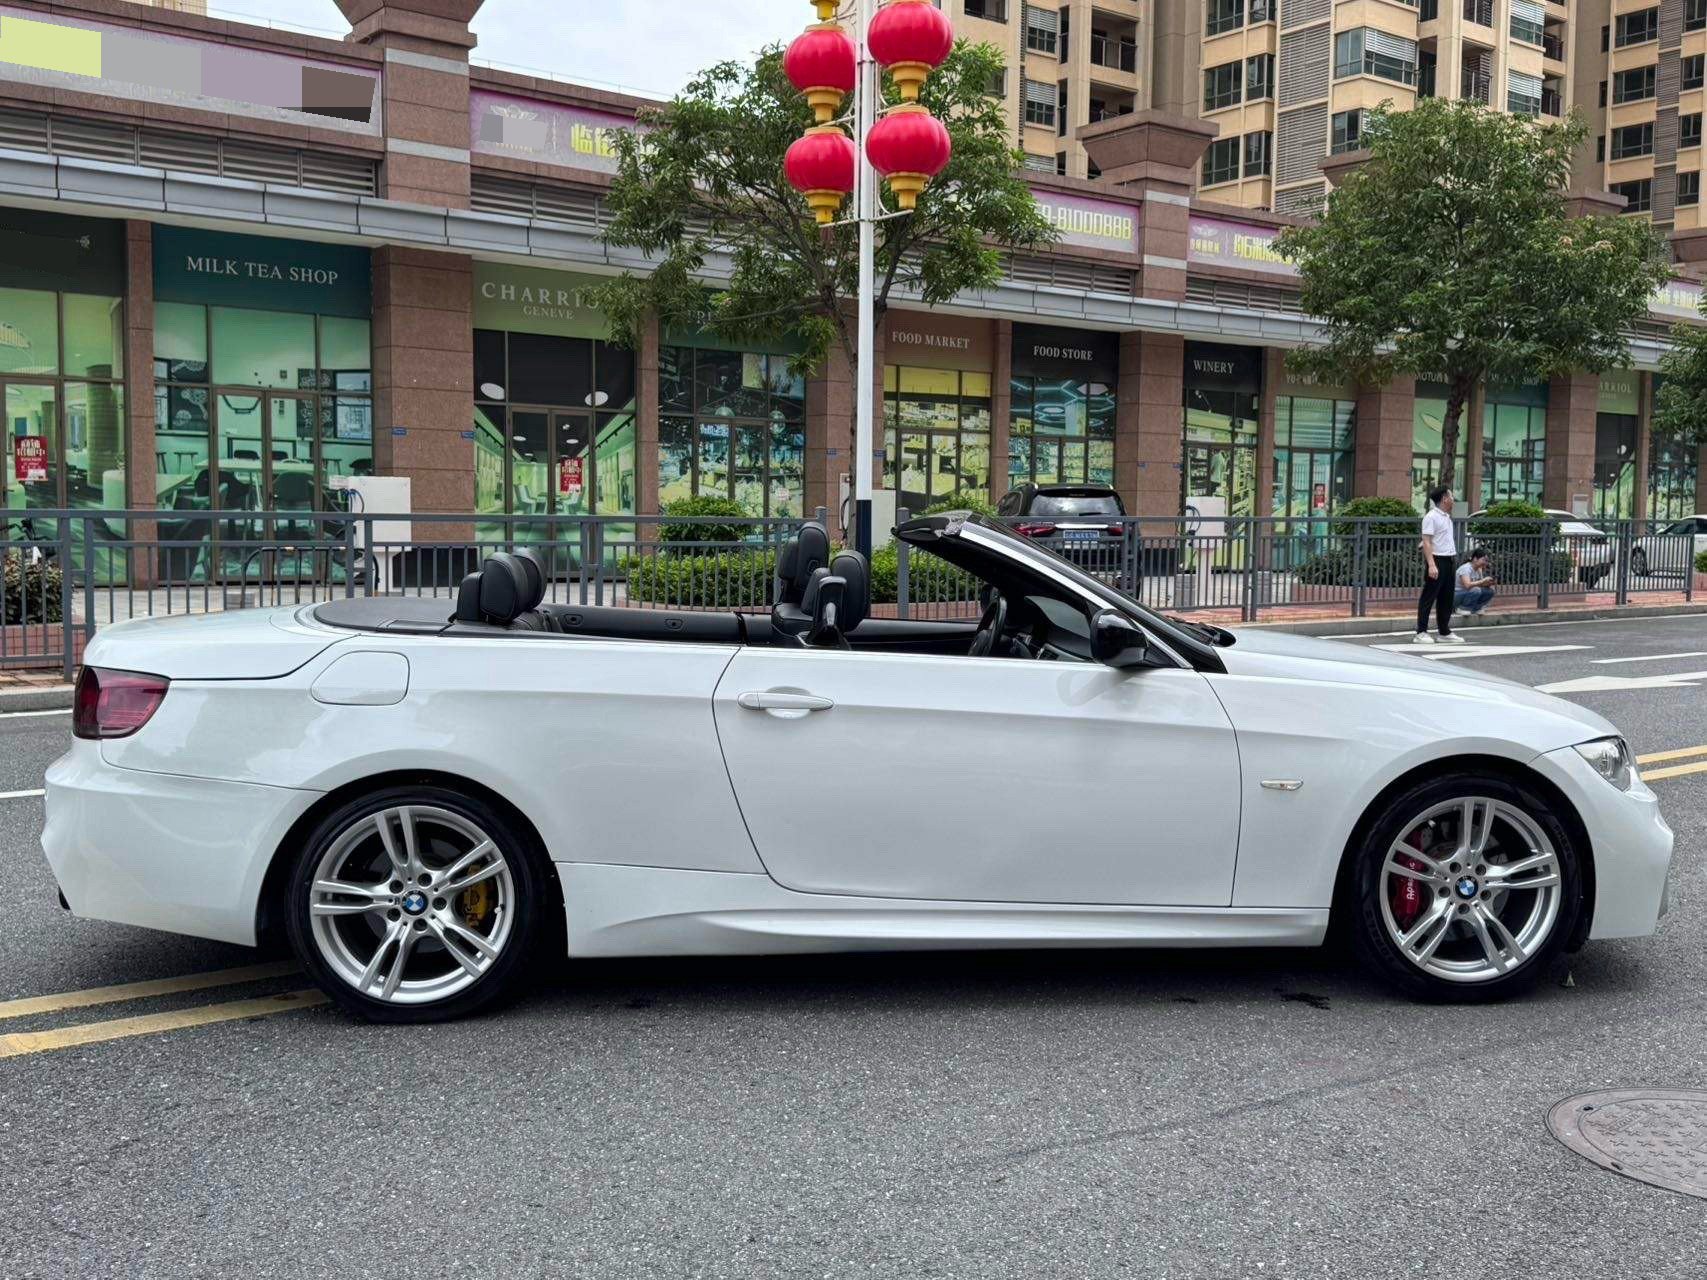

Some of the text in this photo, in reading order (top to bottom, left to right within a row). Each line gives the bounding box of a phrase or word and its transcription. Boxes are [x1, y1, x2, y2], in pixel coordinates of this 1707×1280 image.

[186, 256, 338, 285] MILK TEA SHOP
[892, 331, 970, 349] FOOD MARKET
[1033, 345, 1093, 361] FOOD STORE
[1193, 359, 1235, 375] WINERY
